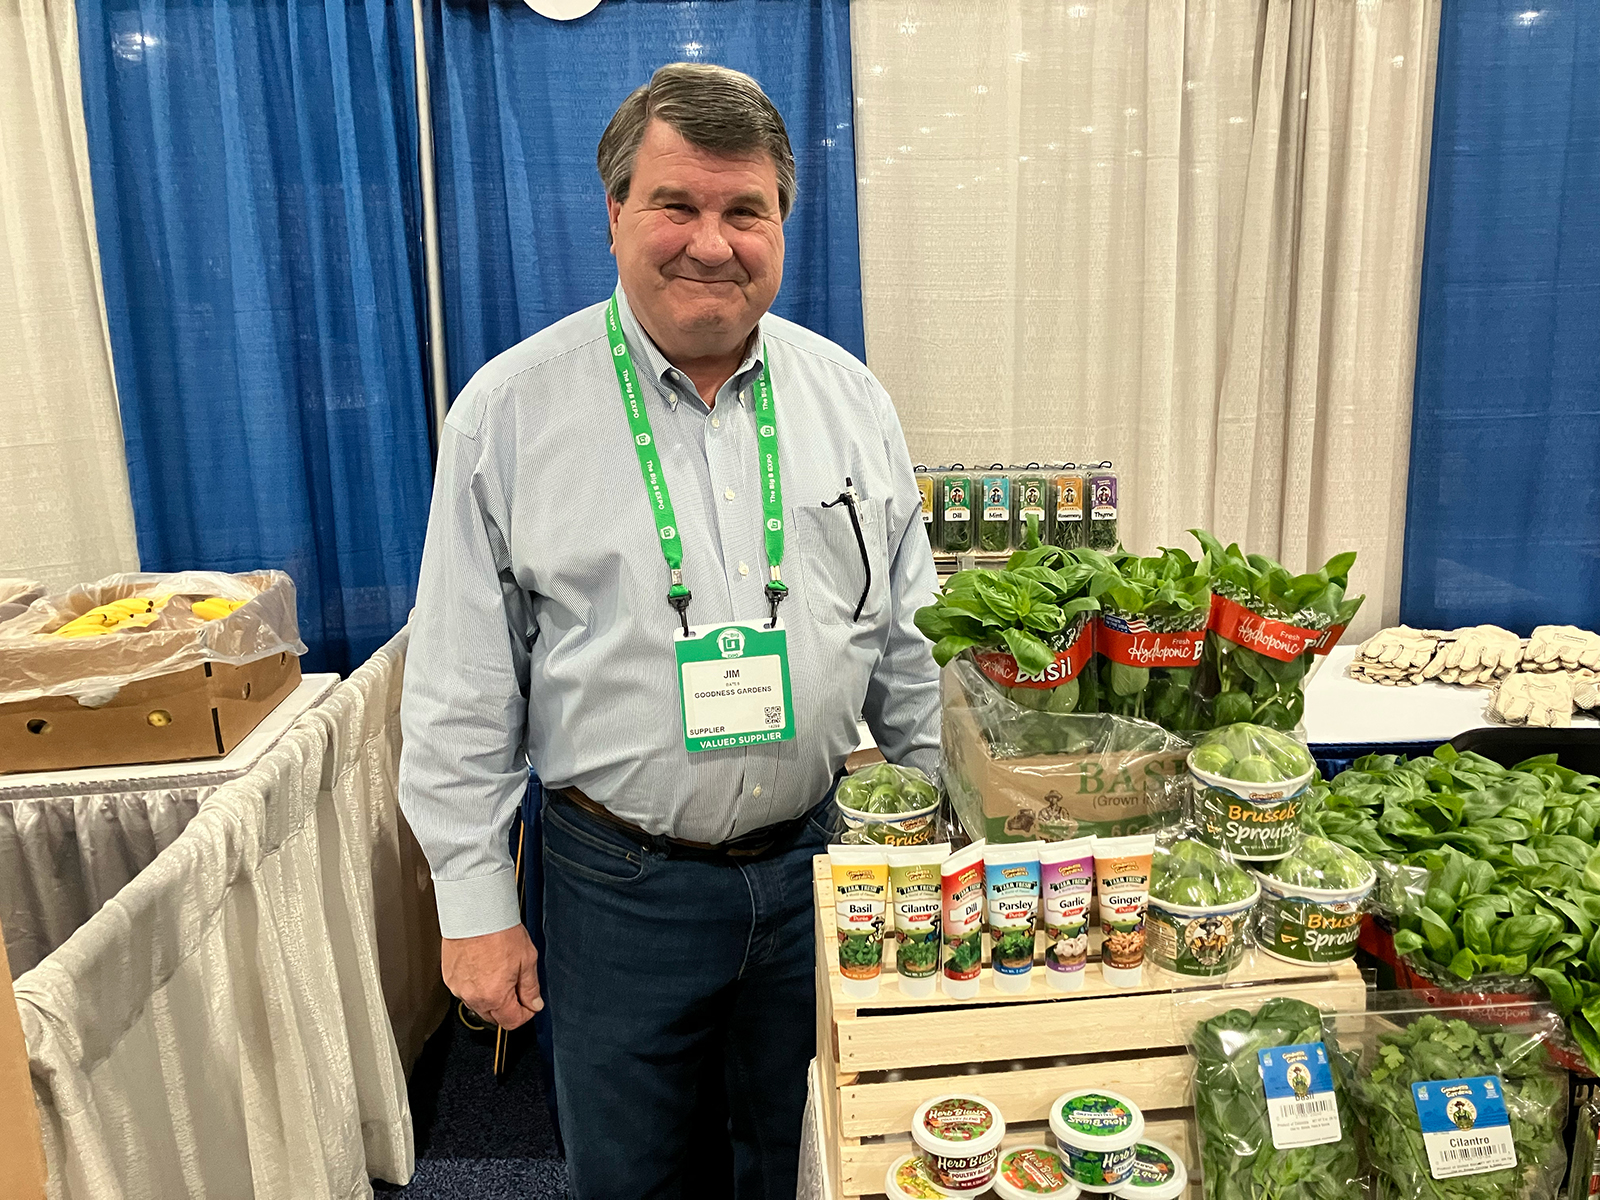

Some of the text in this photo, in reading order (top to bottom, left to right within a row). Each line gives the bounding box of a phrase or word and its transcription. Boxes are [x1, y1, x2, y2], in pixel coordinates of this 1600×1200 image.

[630, 400, 640, 419] EXPO
[654, 491, 665, 510] EXPO
[1237, 616, 1300, 654] Hydroponic
[1280, 630, 1300, 640] Fresh
[1128, 636, 1192, 664] Hydroponic
[723, 669, 740, 679] JIM
[694, 686, 772, 699] GOODNESS GARDENS
[690, 726, 725, 736] SUPPLIER
[699, 732, 782, 749] VALUED SUPPLIER
[1076, 758, 1188, 795] BASI
[1092, 795, 1138, 808] (Grown
[1228, 802, 1297, 823] Brussels
[1225, 821, 1292, 844] Sprouts
[999, 901, 1033, 913] Parsley
[1060, 897, 1085, 909] Garlic
[1109, 895, 1142, 907] Ginger
[849, 904, 872, 913] Basil
[900, 904, 938, 913] Cilantro
[965, 902, 978, 916] Dill
[1460, 998, 1530, 1020] Hydroponi
[1440, 1084, 1469, 1094] Goodness
[928, 1110, 953, 1119] Herb
[1102, 1116, 1128, 1126] Herb
[1449, 1136, 1490, 1148] Cilantro
[938, 1156, 966, 1170] Herb
[1020, 1151, 1043, 1167] Herb
[1102, 1150, 1130, 1168] Herb
[978, 1164, 992, 1174] BLEND
[1141, 1171, 1168, 1182] Herb
